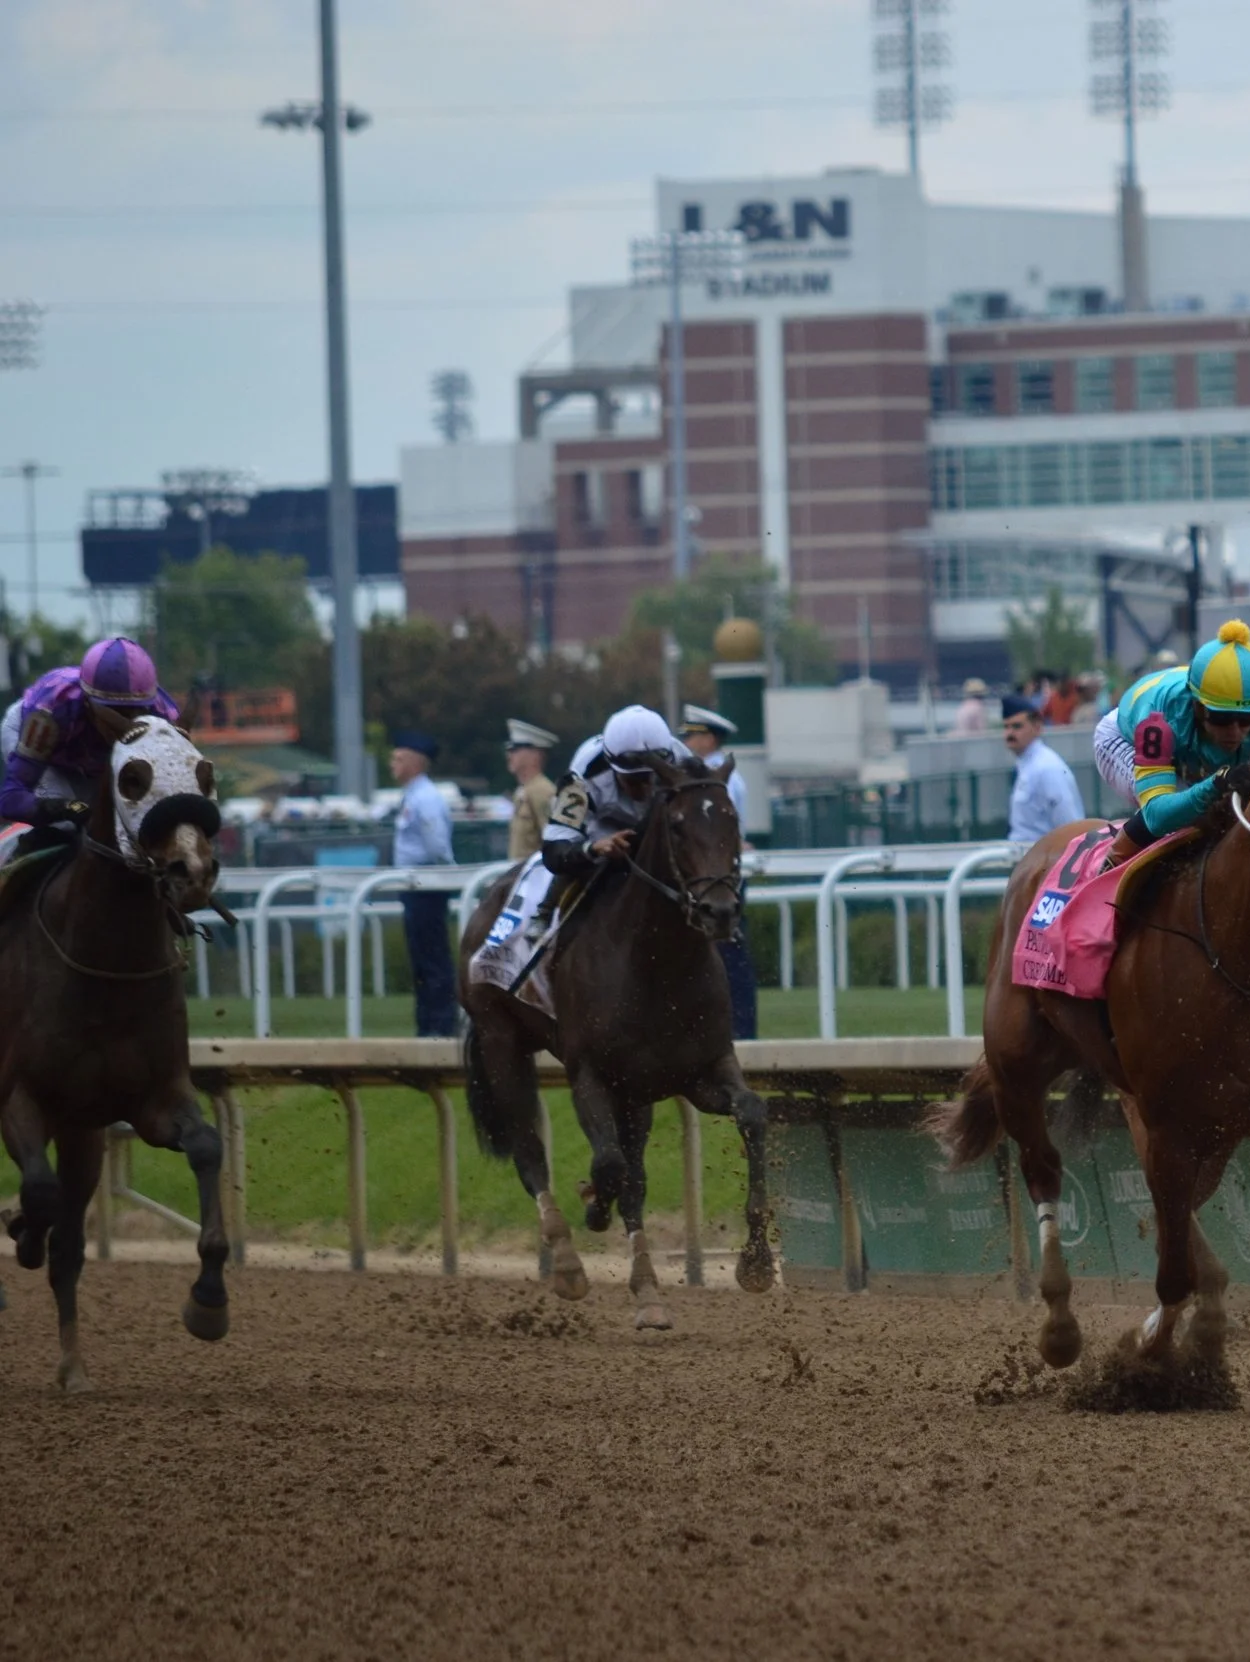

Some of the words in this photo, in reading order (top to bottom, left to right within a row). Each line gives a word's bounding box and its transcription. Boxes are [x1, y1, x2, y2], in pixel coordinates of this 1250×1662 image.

[1143, 726, 1163, 759] 8
[561, 792, 585, 820] 2
[1032, 895, 1066, 925] SAP
